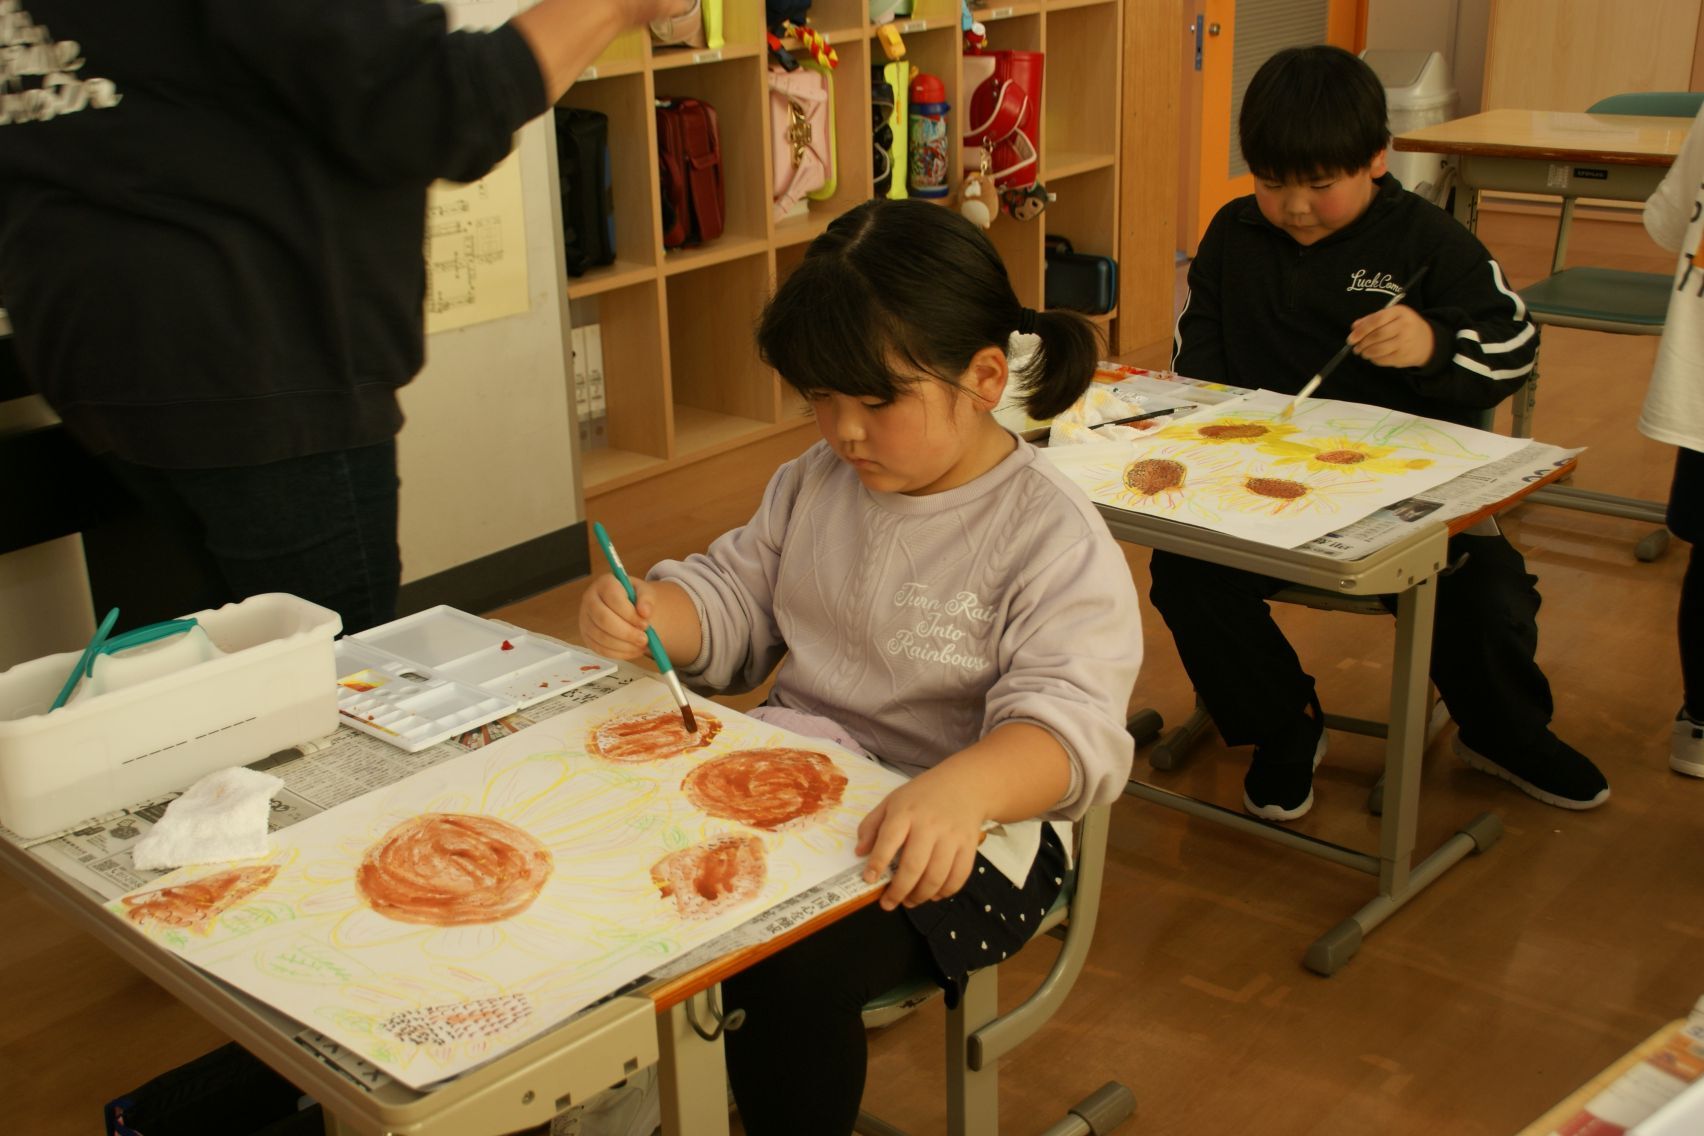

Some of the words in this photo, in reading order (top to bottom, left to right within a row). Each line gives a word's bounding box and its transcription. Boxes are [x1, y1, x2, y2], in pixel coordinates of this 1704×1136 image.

[894, 582, 941, 610] Turn
[916, 612, 966, 641] Into
[887, 629, 990, 671] Rainbows
